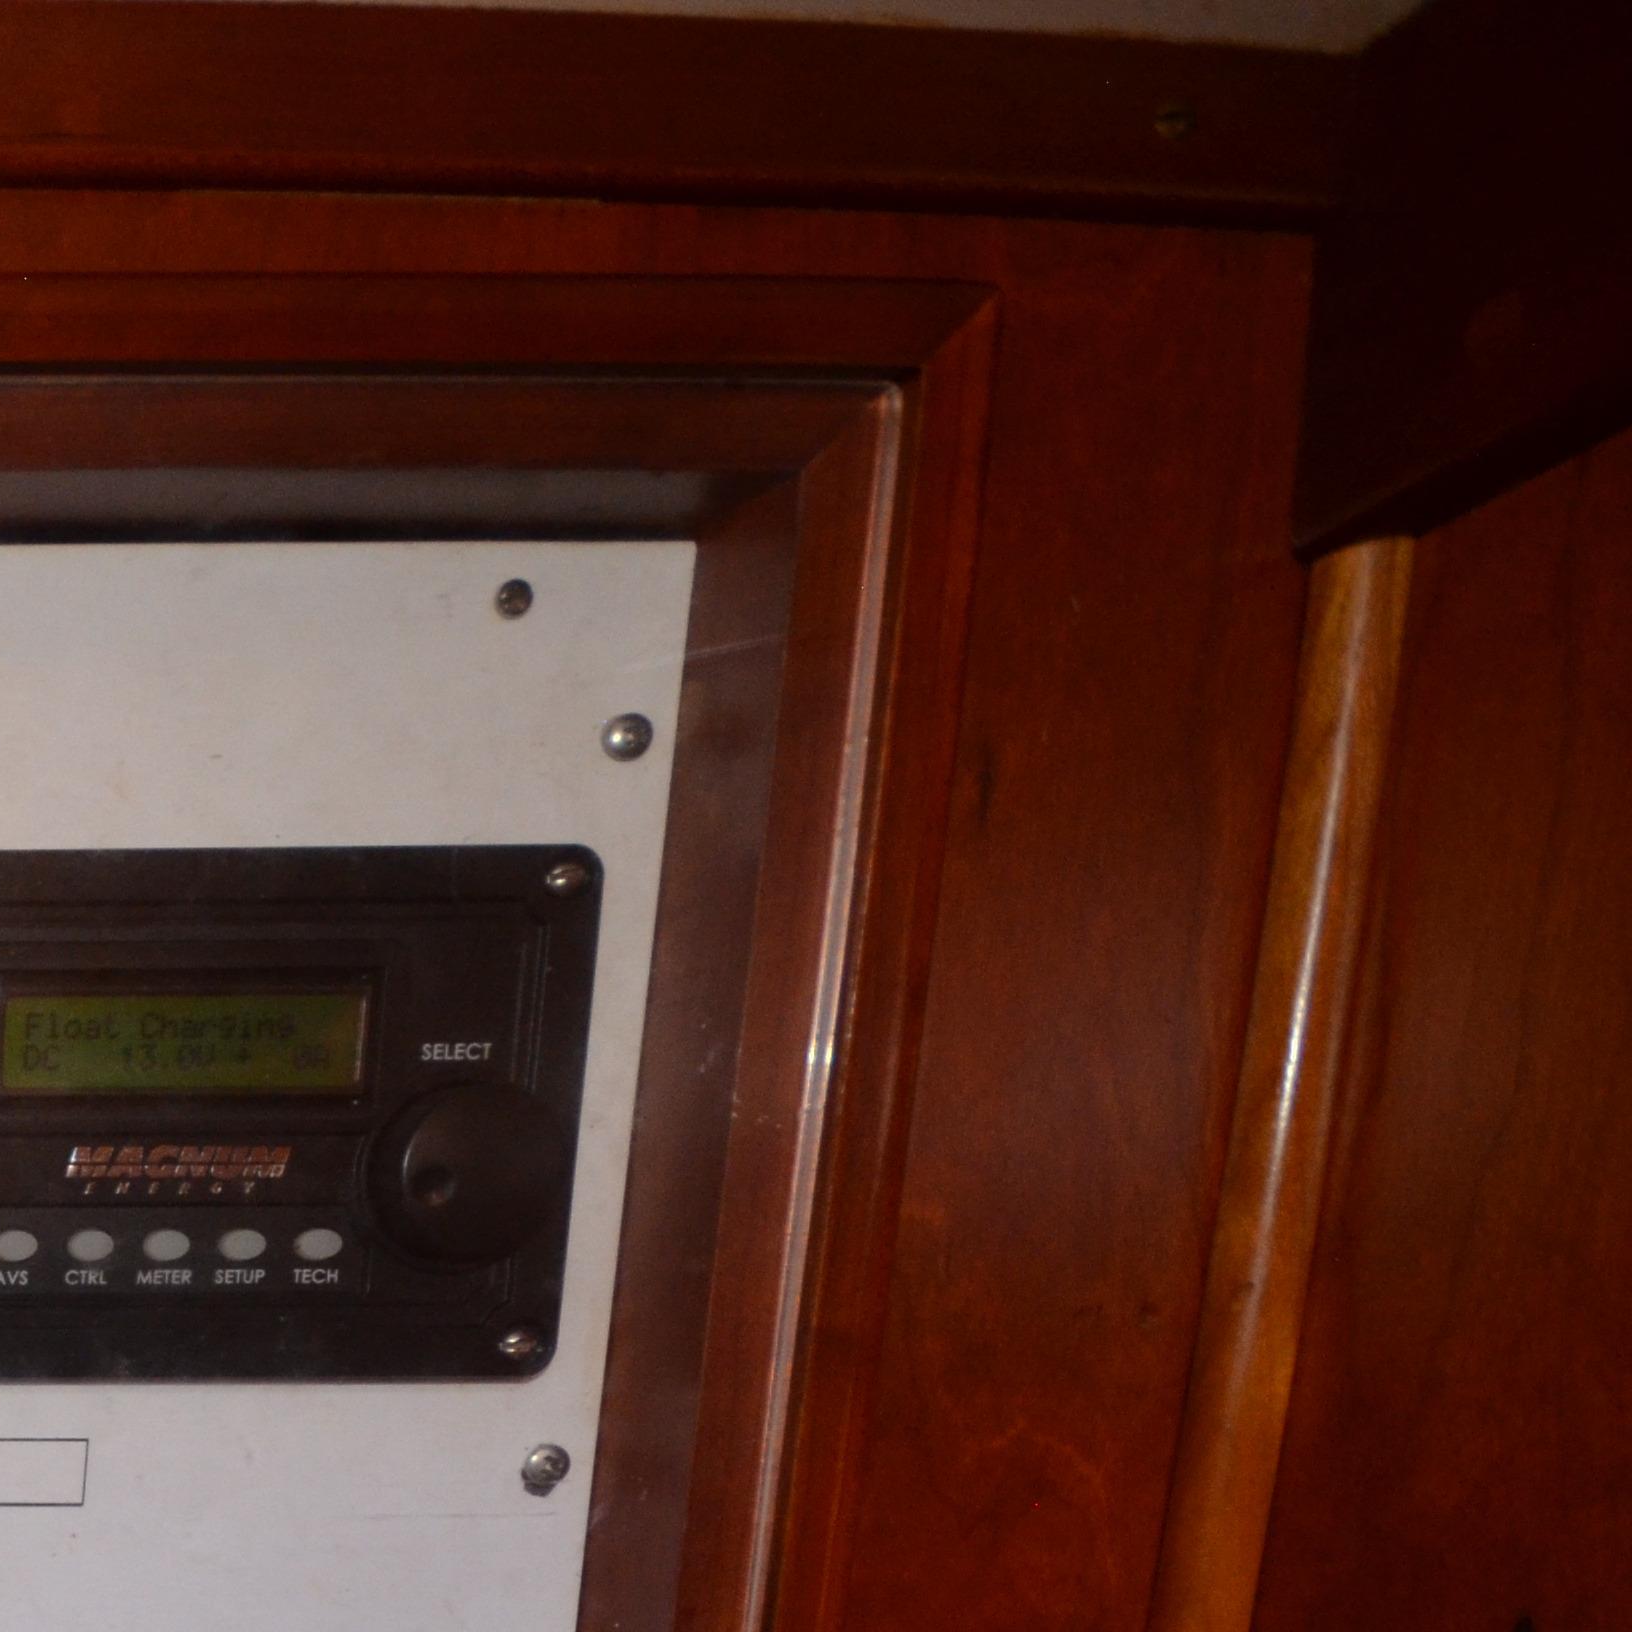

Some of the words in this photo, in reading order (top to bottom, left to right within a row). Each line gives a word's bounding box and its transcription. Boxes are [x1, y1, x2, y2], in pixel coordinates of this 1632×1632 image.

[422, 1043, 492, 1061] SELECT
[66, 1146, 294, 1178] MAGNUM
[65, 1270, 107, 1286] CTRL
[137, 1270, 192, 1285] METER
[214, 1268, 265, 1285] SETUP
[294, 1269, 338, 1284] TECH
